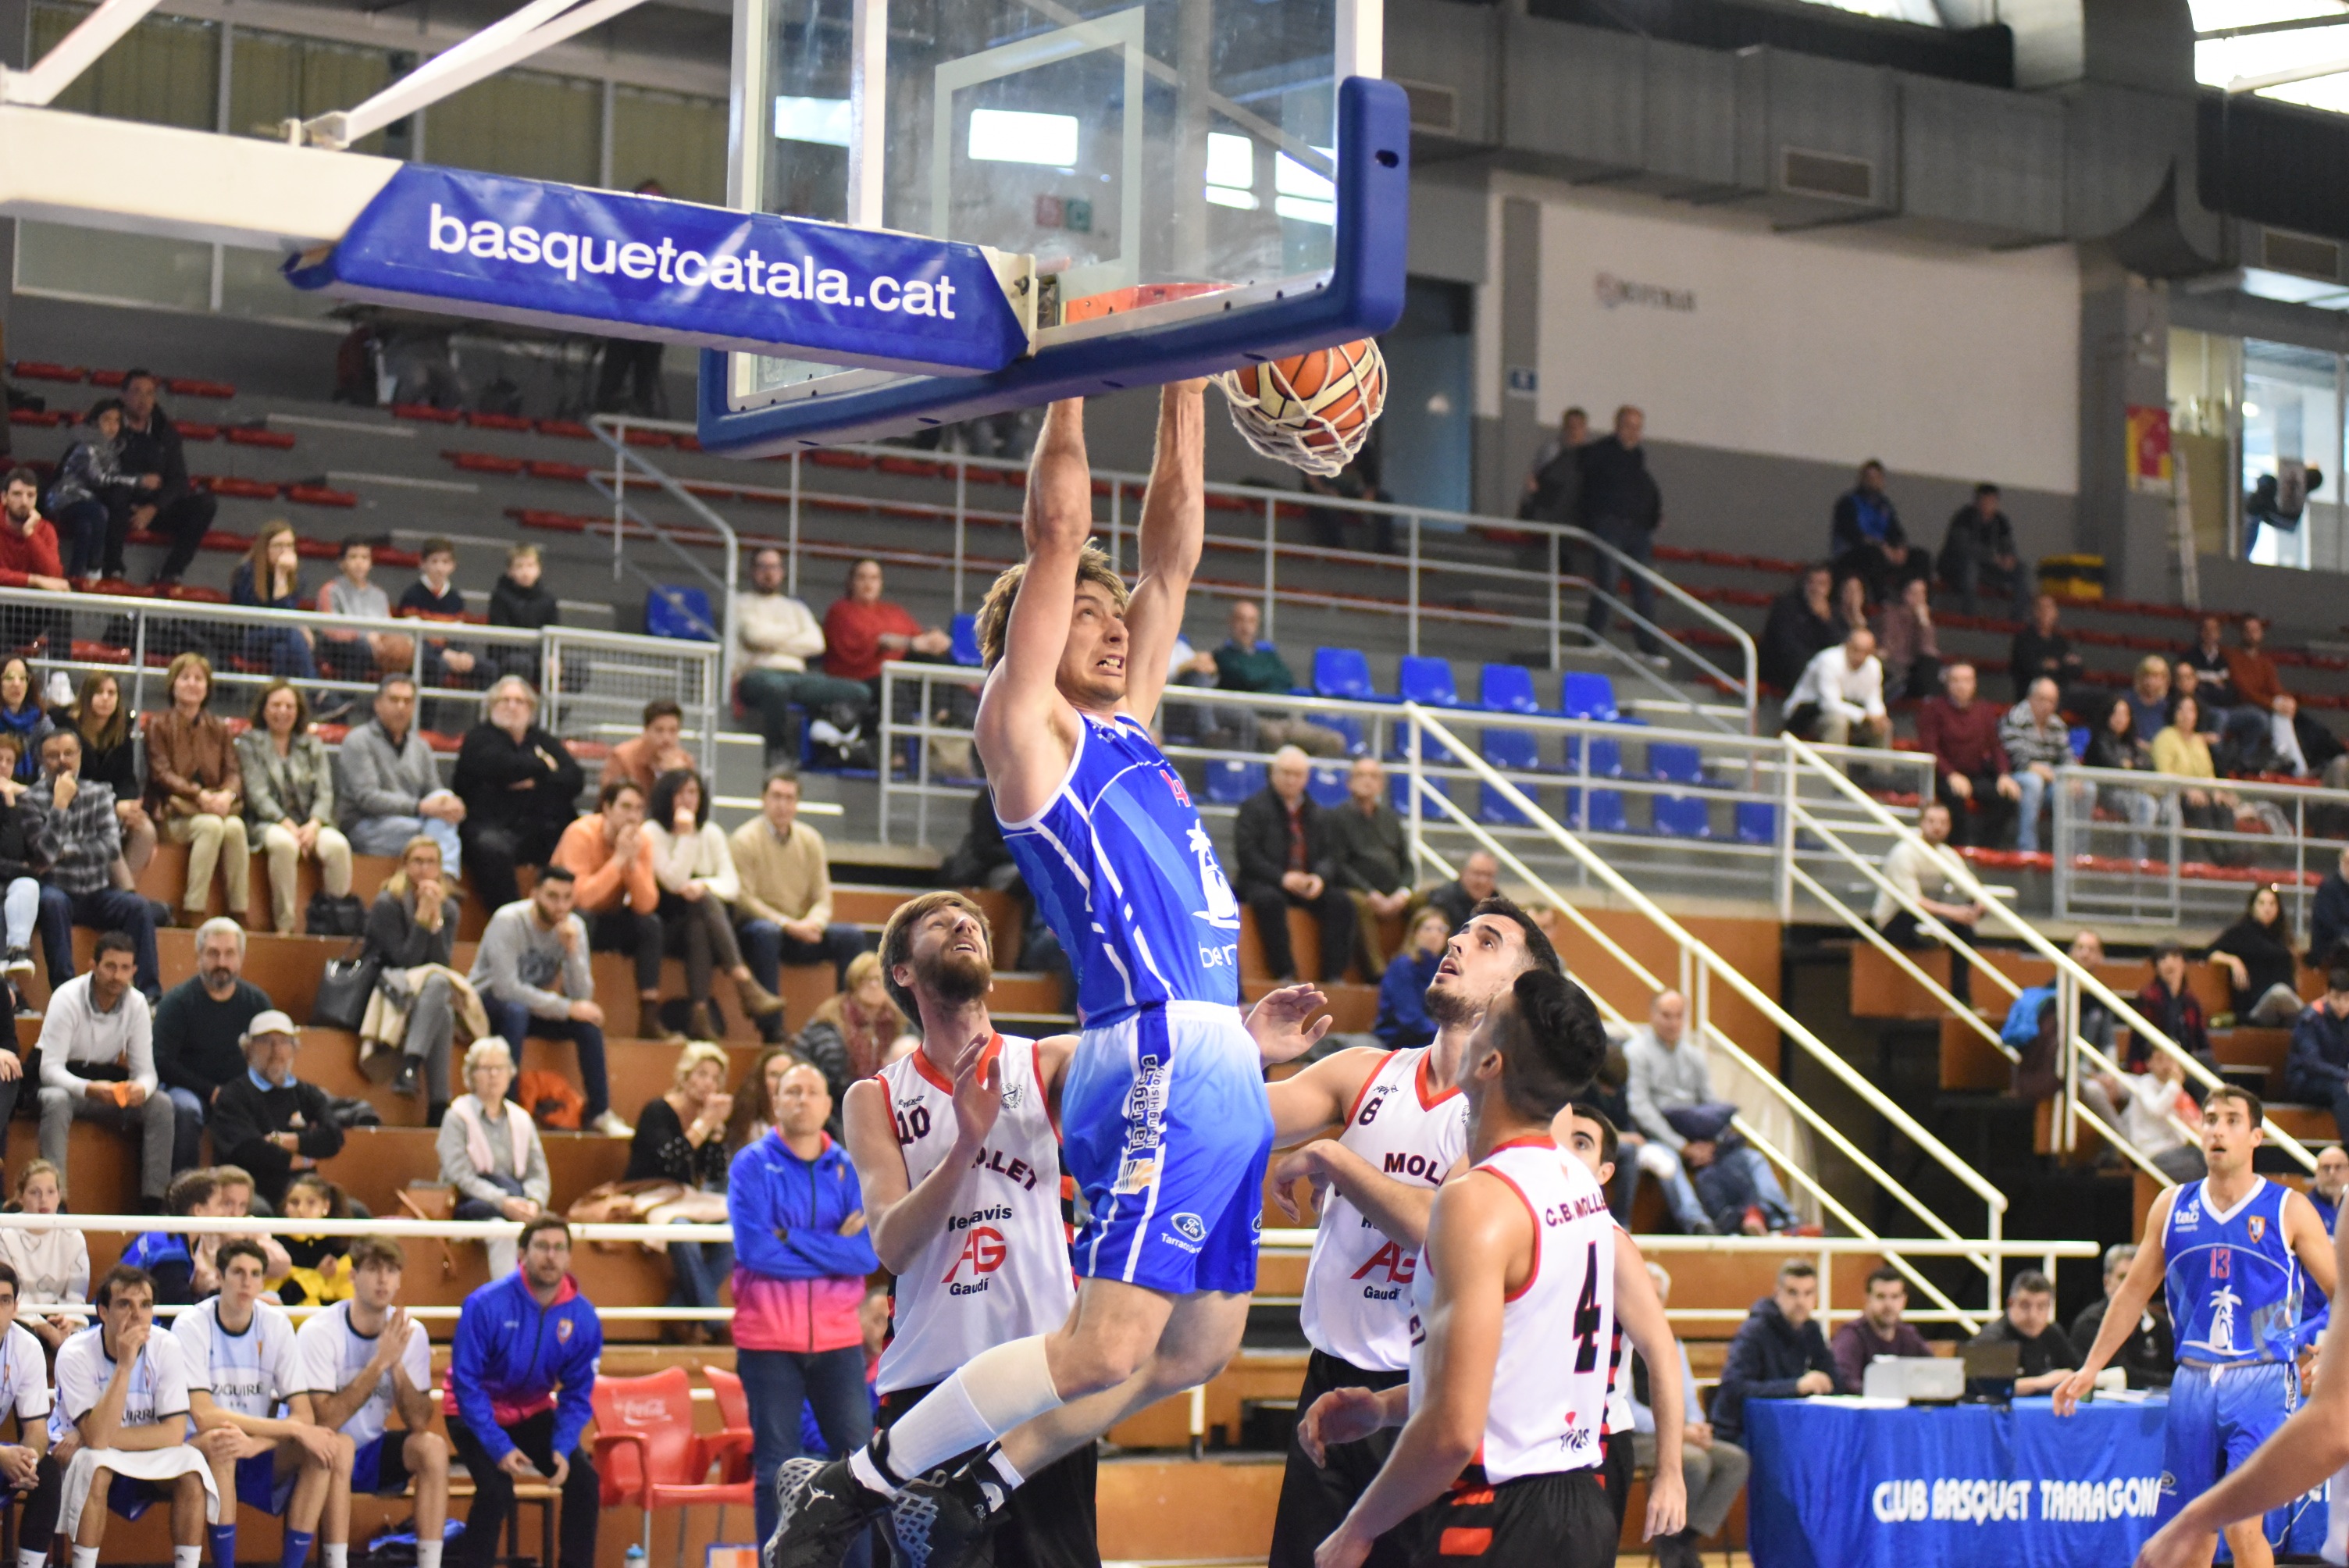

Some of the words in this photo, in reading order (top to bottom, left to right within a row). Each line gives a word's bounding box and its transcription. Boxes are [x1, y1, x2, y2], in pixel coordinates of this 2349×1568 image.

[429, 203, 956, 320] basquetcatala.cat
[897, 1106, 930, 1146] 10
[1383, 1152, 1449, 1187] MOL
[2210, 1248, 2231, 1279] 13
[950, 1278, 989, 1295] Gaudí
[1573, 1240, 1601, 1374] 4
[1873, 1478, 1928, 1523] CLUB
[1931, 1477, 2032, 1526] BASQUET
